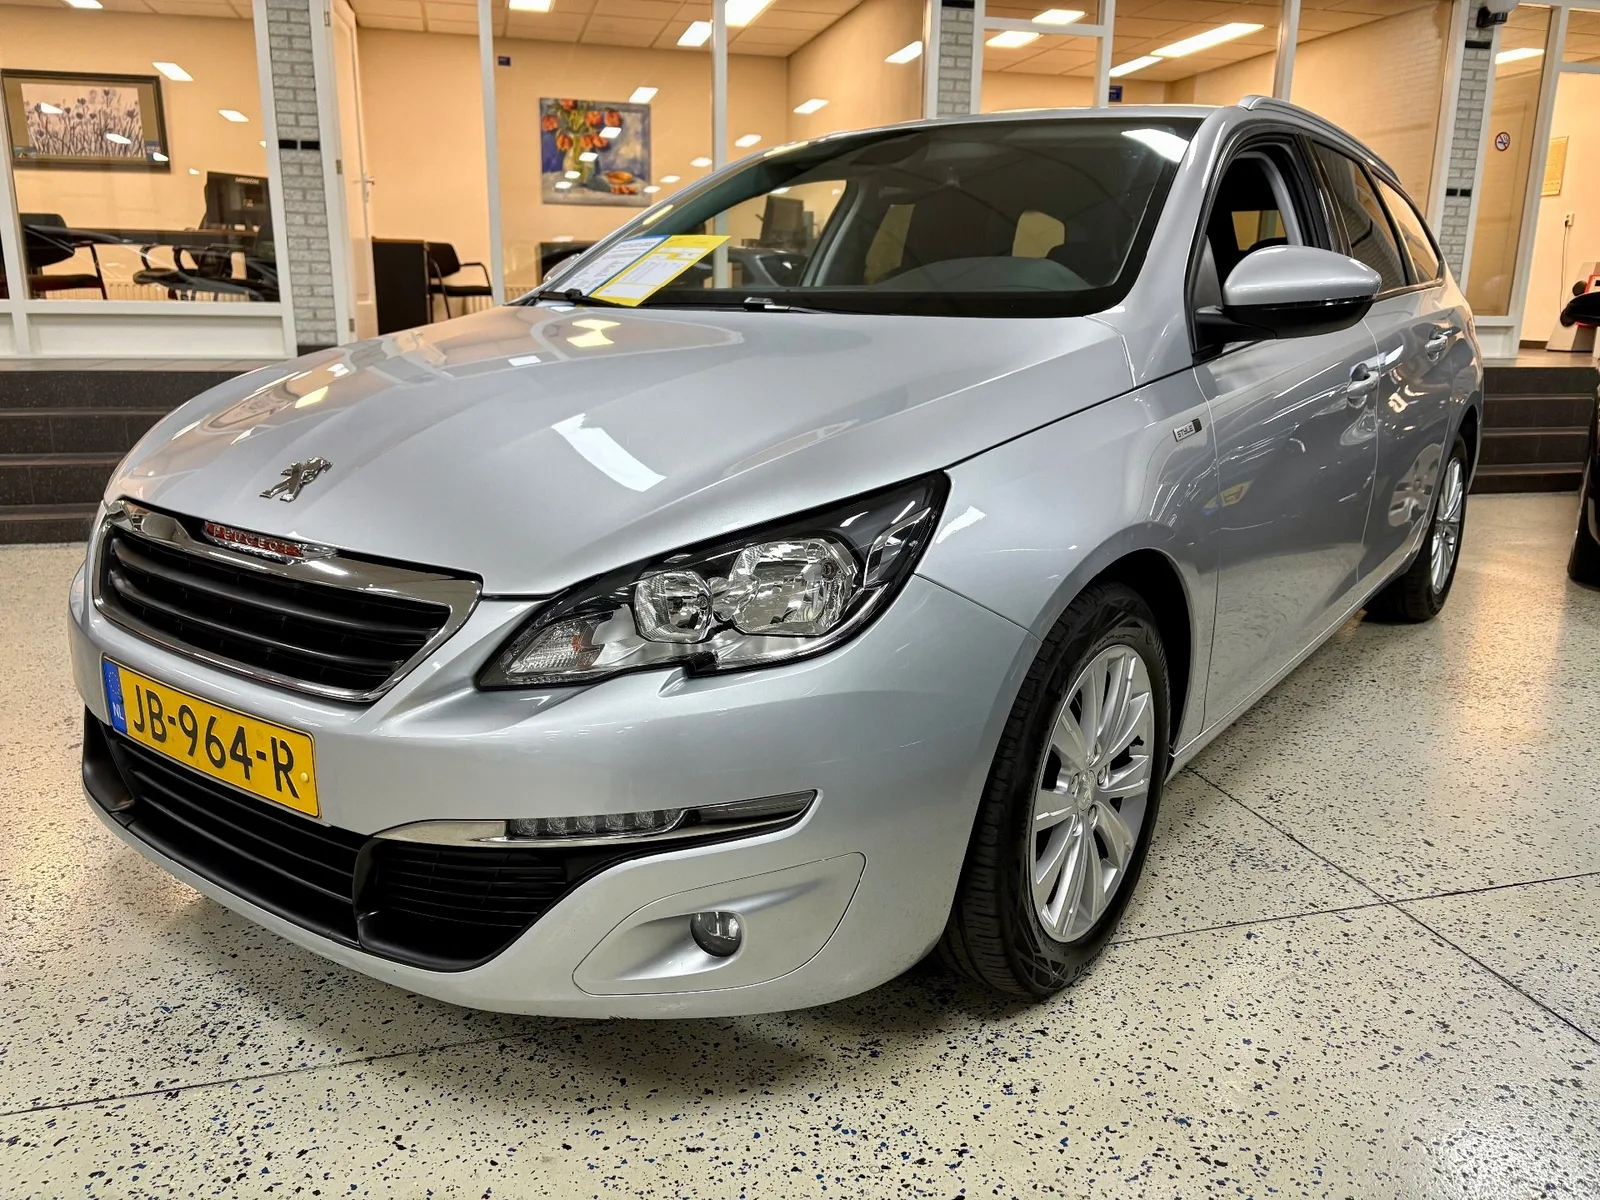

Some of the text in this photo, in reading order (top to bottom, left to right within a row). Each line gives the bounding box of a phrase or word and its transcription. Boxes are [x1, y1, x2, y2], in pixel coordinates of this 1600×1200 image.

[1176, 424, 1194, 438] STYLE
[211, 522, 291, 555] PEUGEOT
[112, 702, 125, 721] NL
[133, 684, 301, 800] JB-964-R
